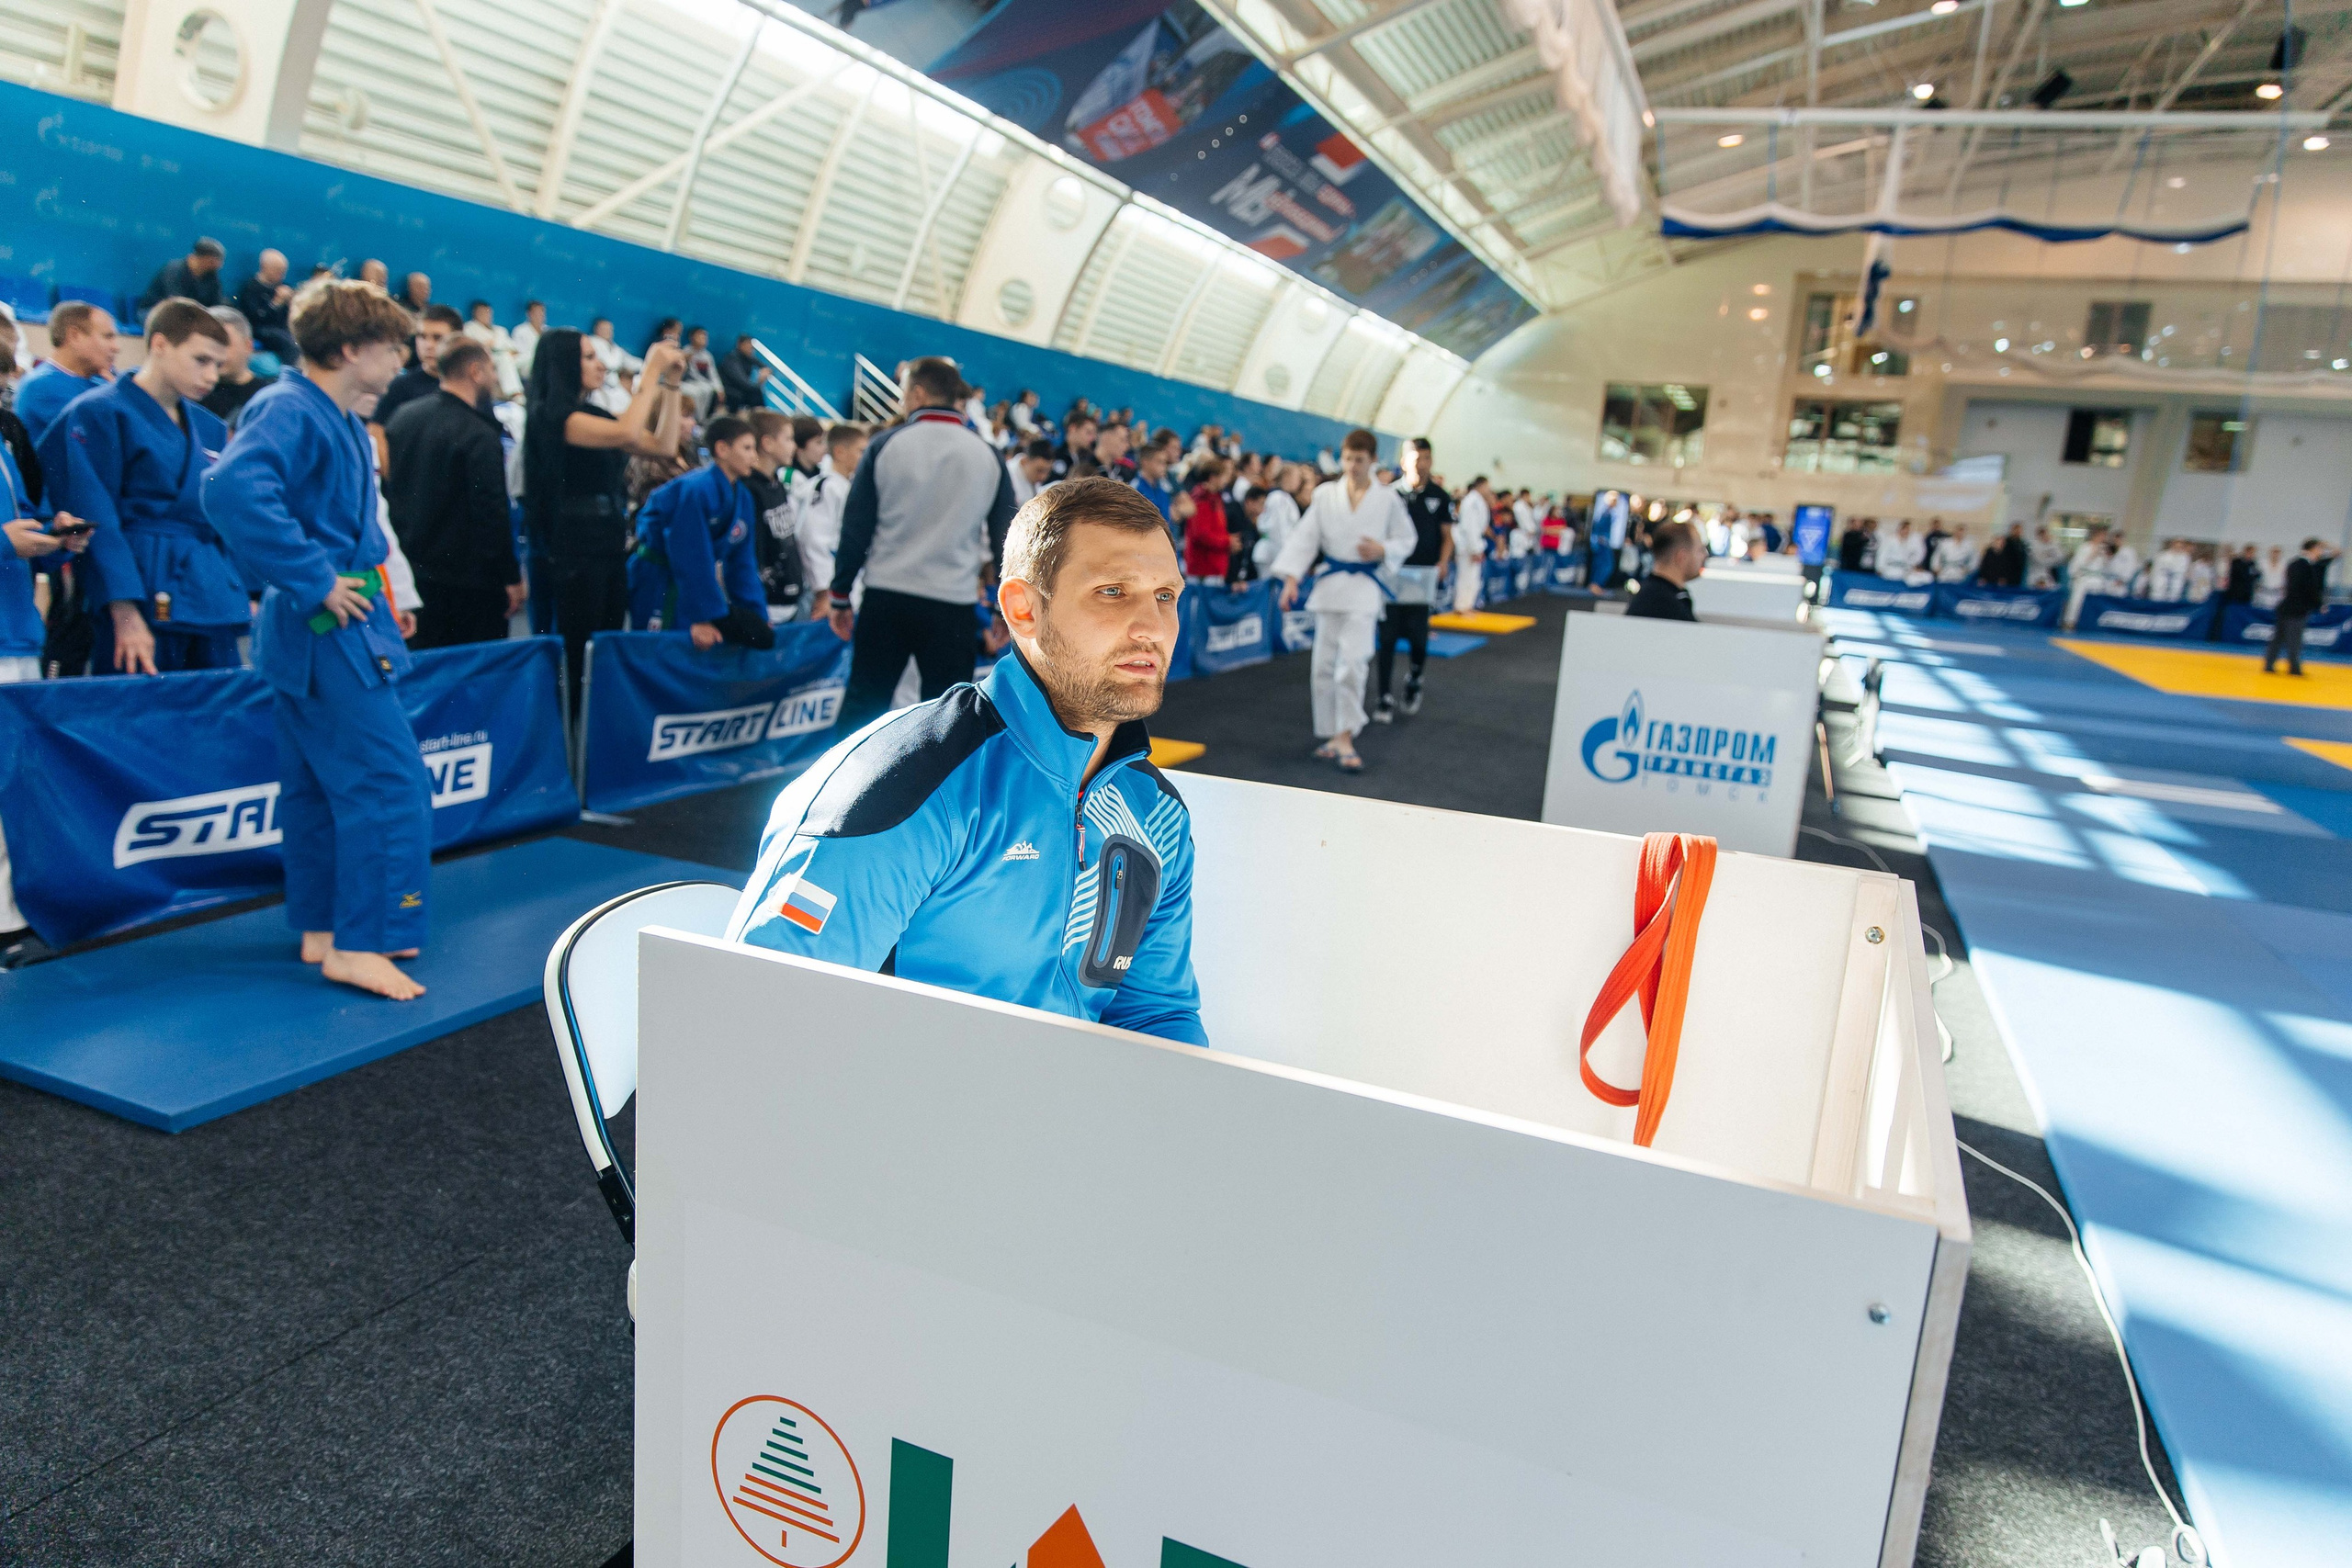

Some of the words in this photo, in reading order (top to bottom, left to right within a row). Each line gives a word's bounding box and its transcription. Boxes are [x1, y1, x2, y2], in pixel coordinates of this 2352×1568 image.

[659, 711, 766, 750] START
[775, 696, 835, 728] LINE
[1645, 720, 1777, 764] ГАЗПРОМ
[127, 793, 281, 852] STA
[426, 756, 477, 796] NE
[1001, 853, 1040, 862] FORWARD
